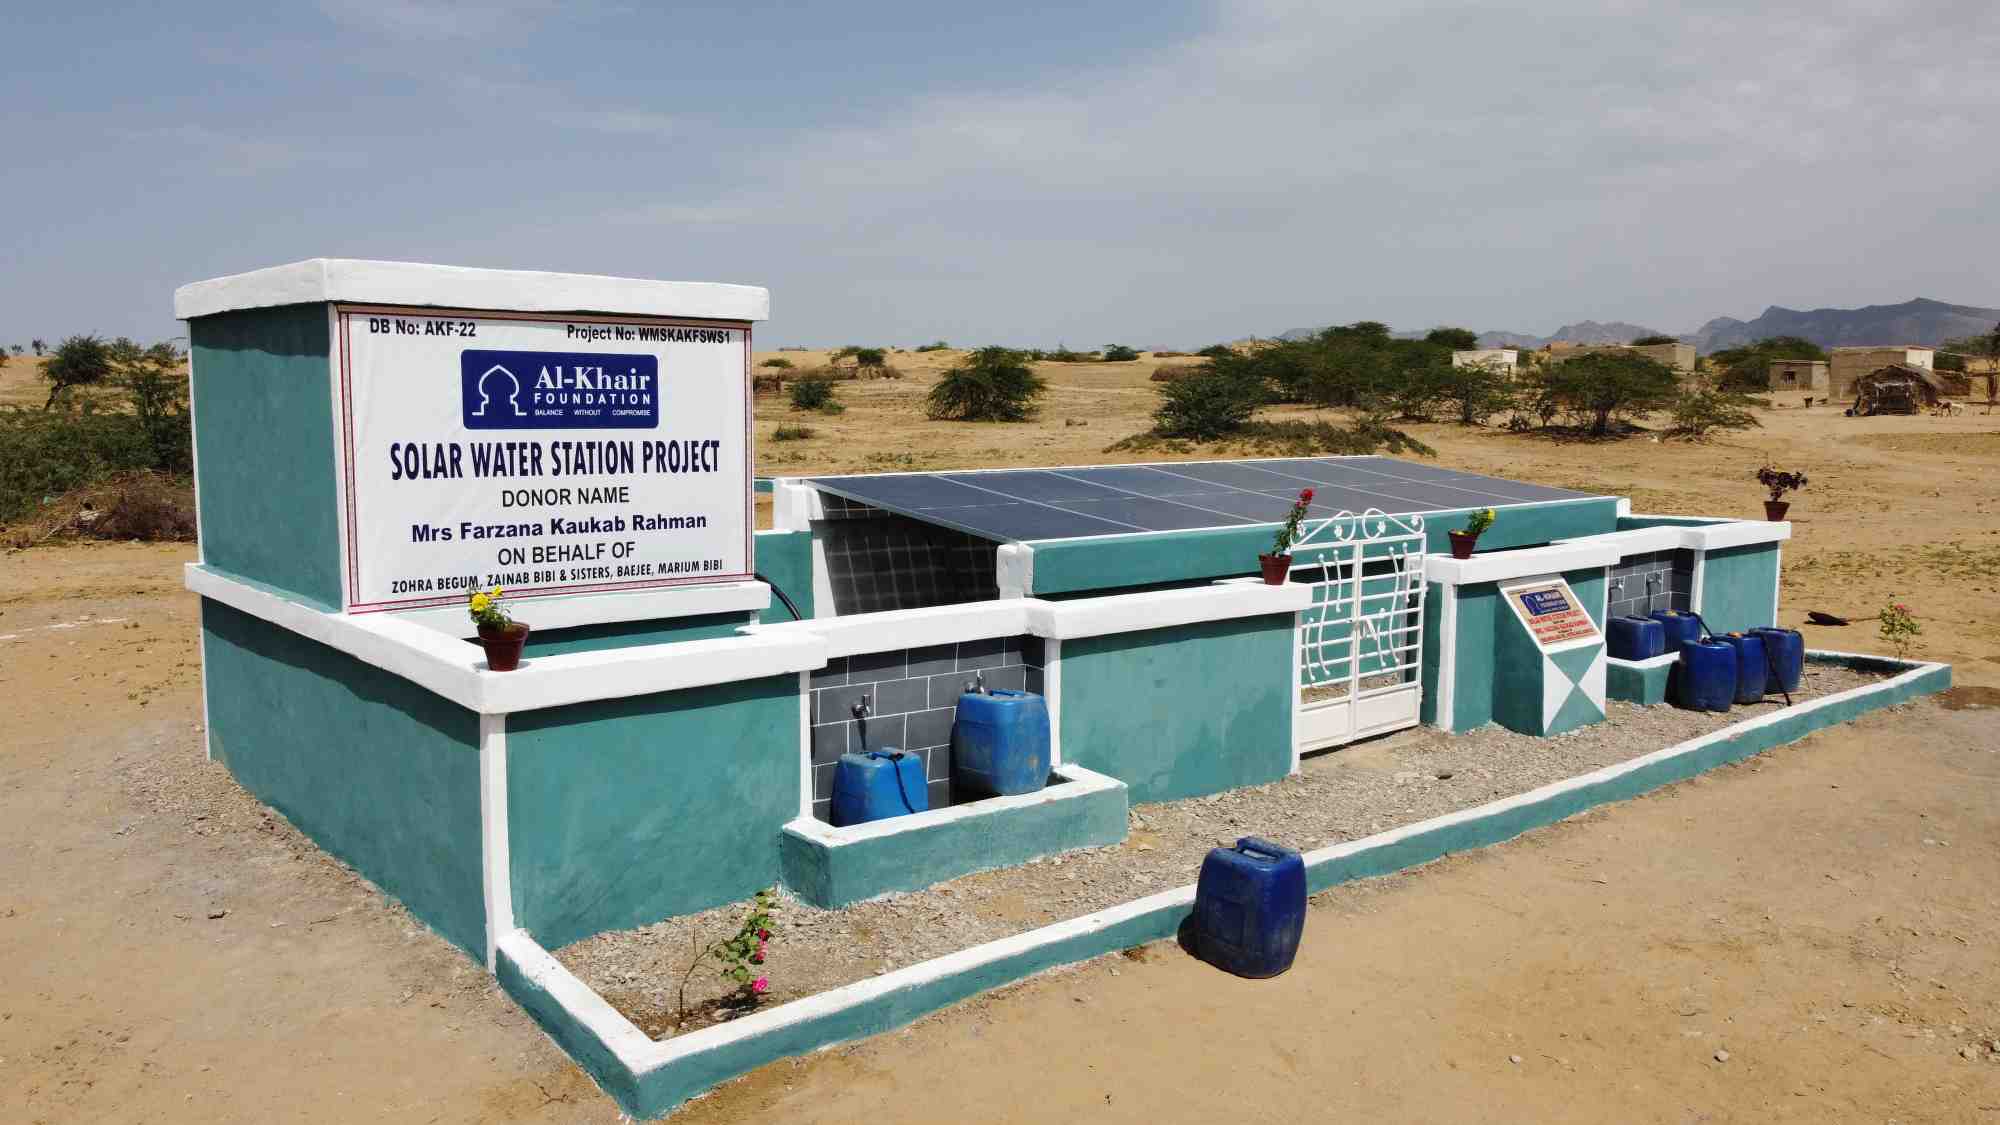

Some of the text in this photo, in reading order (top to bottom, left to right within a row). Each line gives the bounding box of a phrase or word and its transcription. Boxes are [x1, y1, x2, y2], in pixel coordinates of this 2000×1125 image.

[369, 318, 476, 337] DB No: AKF-22
[567, 324, 730, 344] Project No: WMSKAKFSWS1
[535, 365, 650, 391] Al-Khair
[535, 392, 650, 405] FOUNDATION
[390, 440, 720, 480] SOLAR WATER STATION PROJECT
[502, 486, 630, 507] DONOR NAME
[412, 514, 707, 542] Mrs Farzana Kaukab Rahman
[498, 541, 636, 565] ON BEHALF OF
[392, 559, 723, 593] ZOHRA BEGUM, ZAINAB BIBI & SISTERS, BAEJEE, MARIUM BIBI
